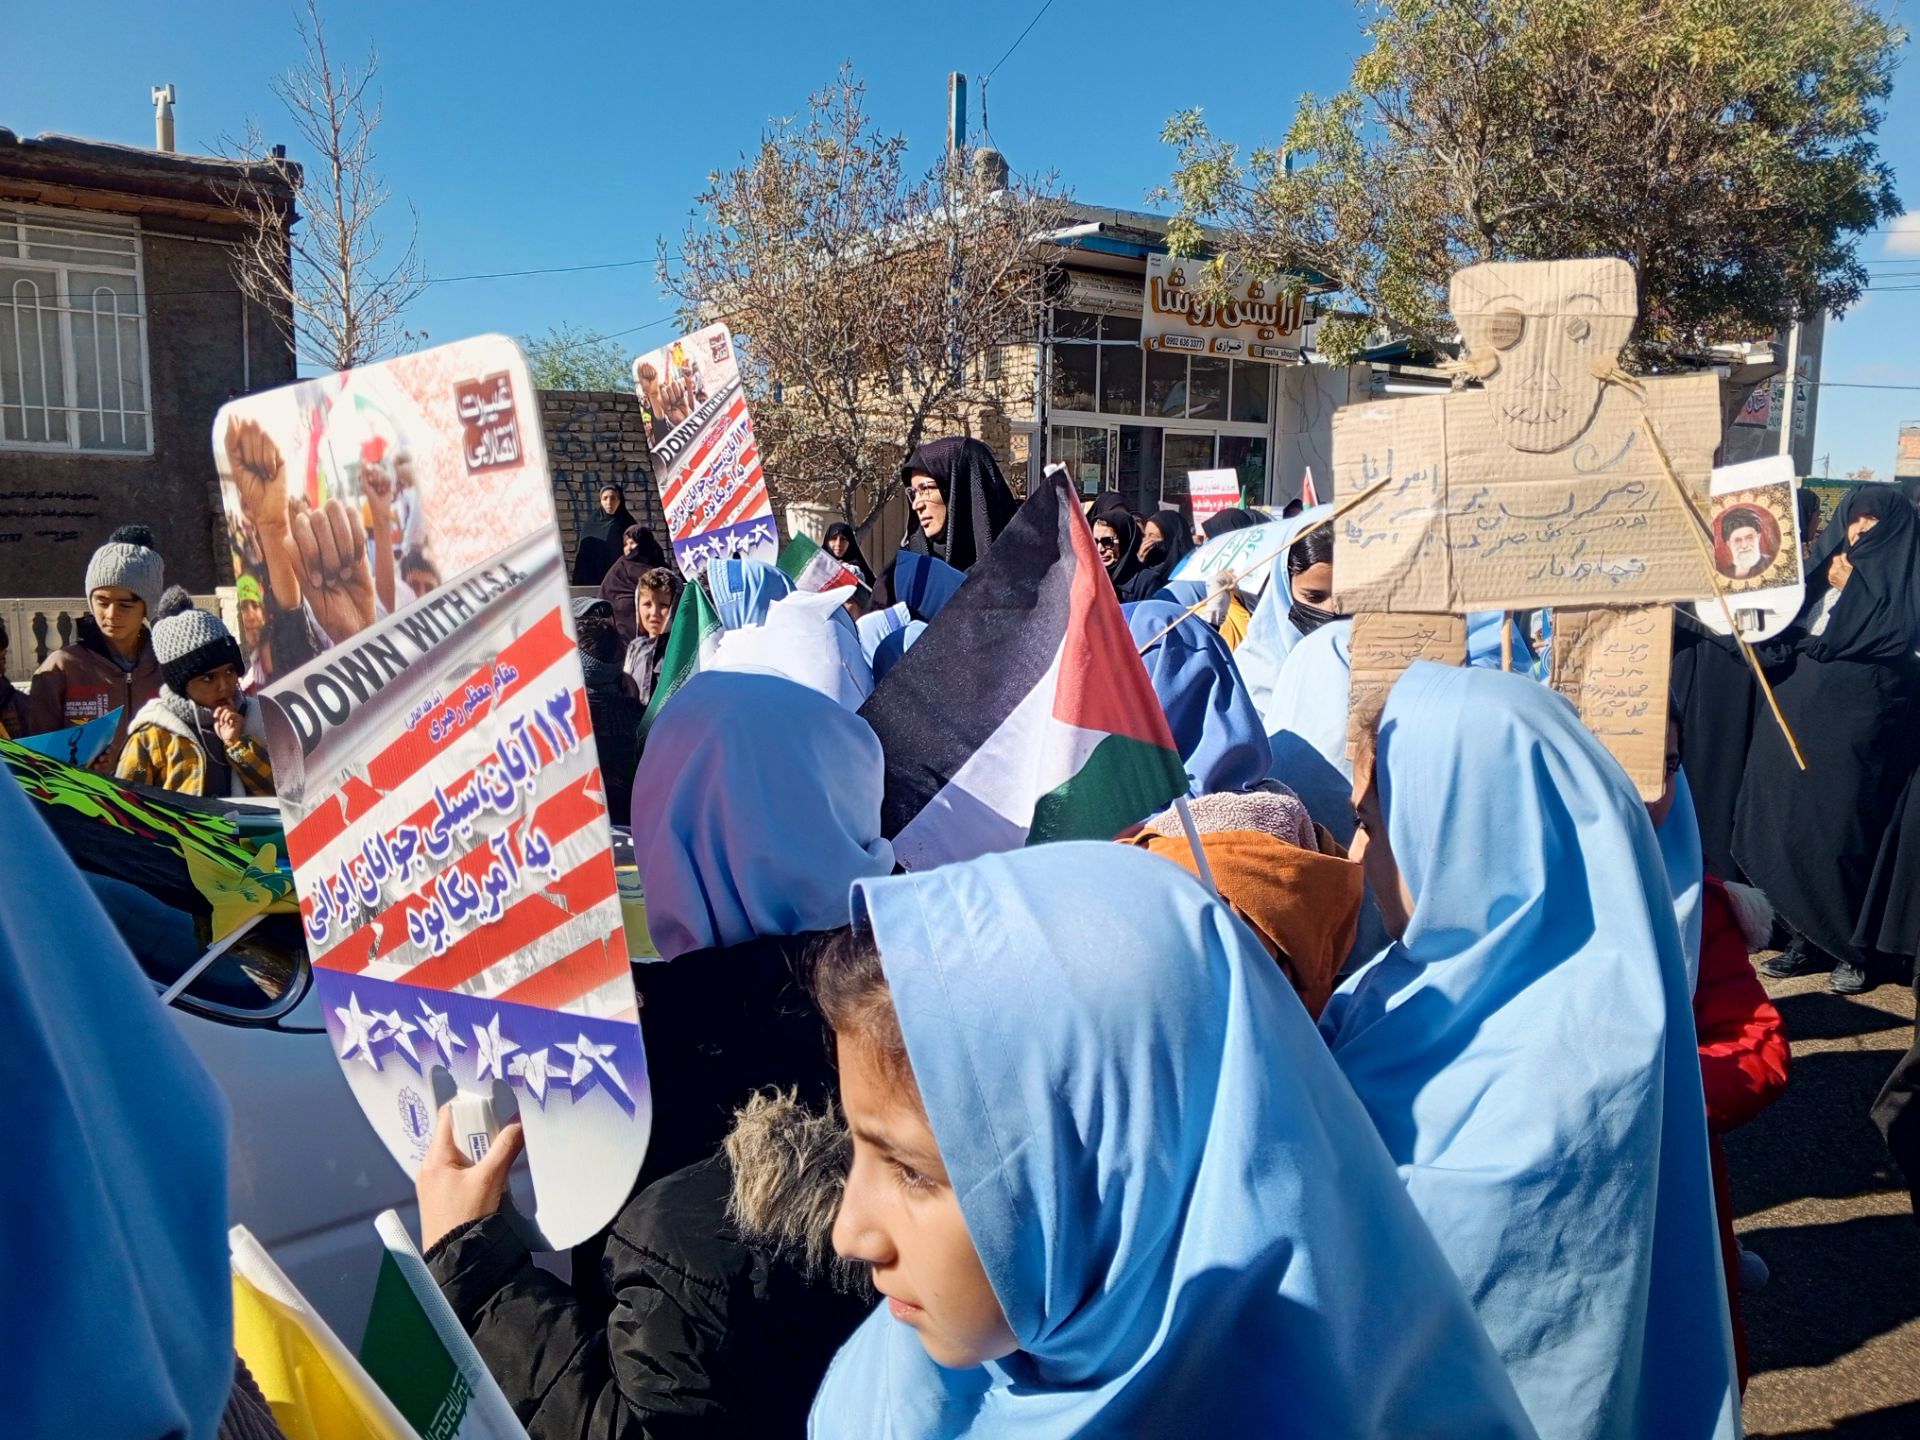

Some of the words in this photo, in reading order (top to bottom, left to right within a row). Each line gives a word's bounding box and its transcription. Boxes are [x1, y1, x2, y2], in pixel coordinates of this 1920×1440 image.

[656, 419, 700, 467] DOWN
[695, 399, 718, 421] WITH
[274, 634, 410, 757] DOWN
[395, 590, 475, 653] WITH
[463, 684, 493, 719] معظم
[493, 664, 518, 695] مقام
[429, 704, 466, 742] رهبری
[423, 783, 481, 860] سیلی
[523, 828, 559, 877] به
[356, 825, 422, 903] جوانان
[437, 830, 519, 922] آمریکا
[306, 857, 358, 942] ایرانی
[407, 893, 452, 955] بود
